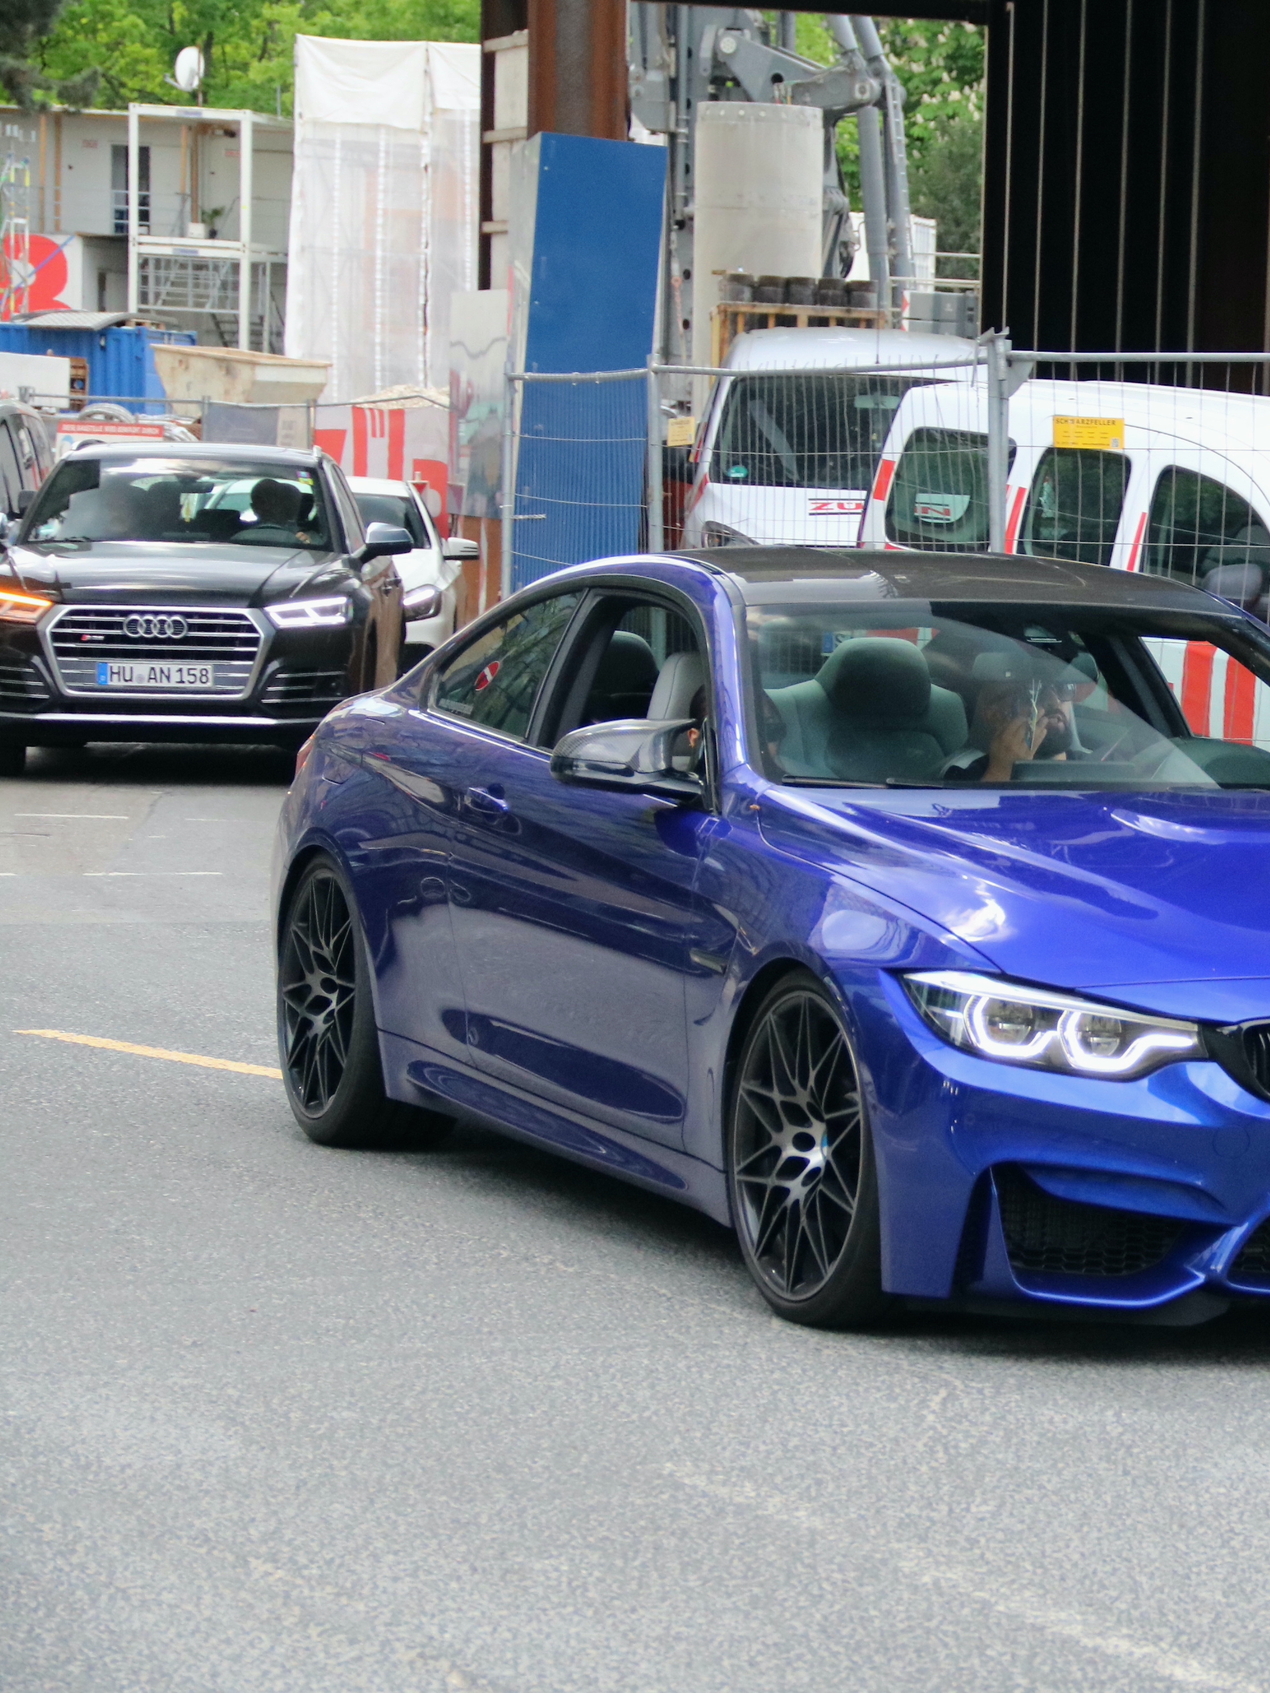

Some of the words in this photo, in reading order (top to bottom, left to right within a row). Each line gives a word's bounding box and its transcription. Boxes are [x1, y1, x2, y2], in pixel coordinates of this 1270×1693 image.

[109, 666, 133, 682] HU
[147, 667, 171, 683] AN
[175, 667, 209, 684] 158
